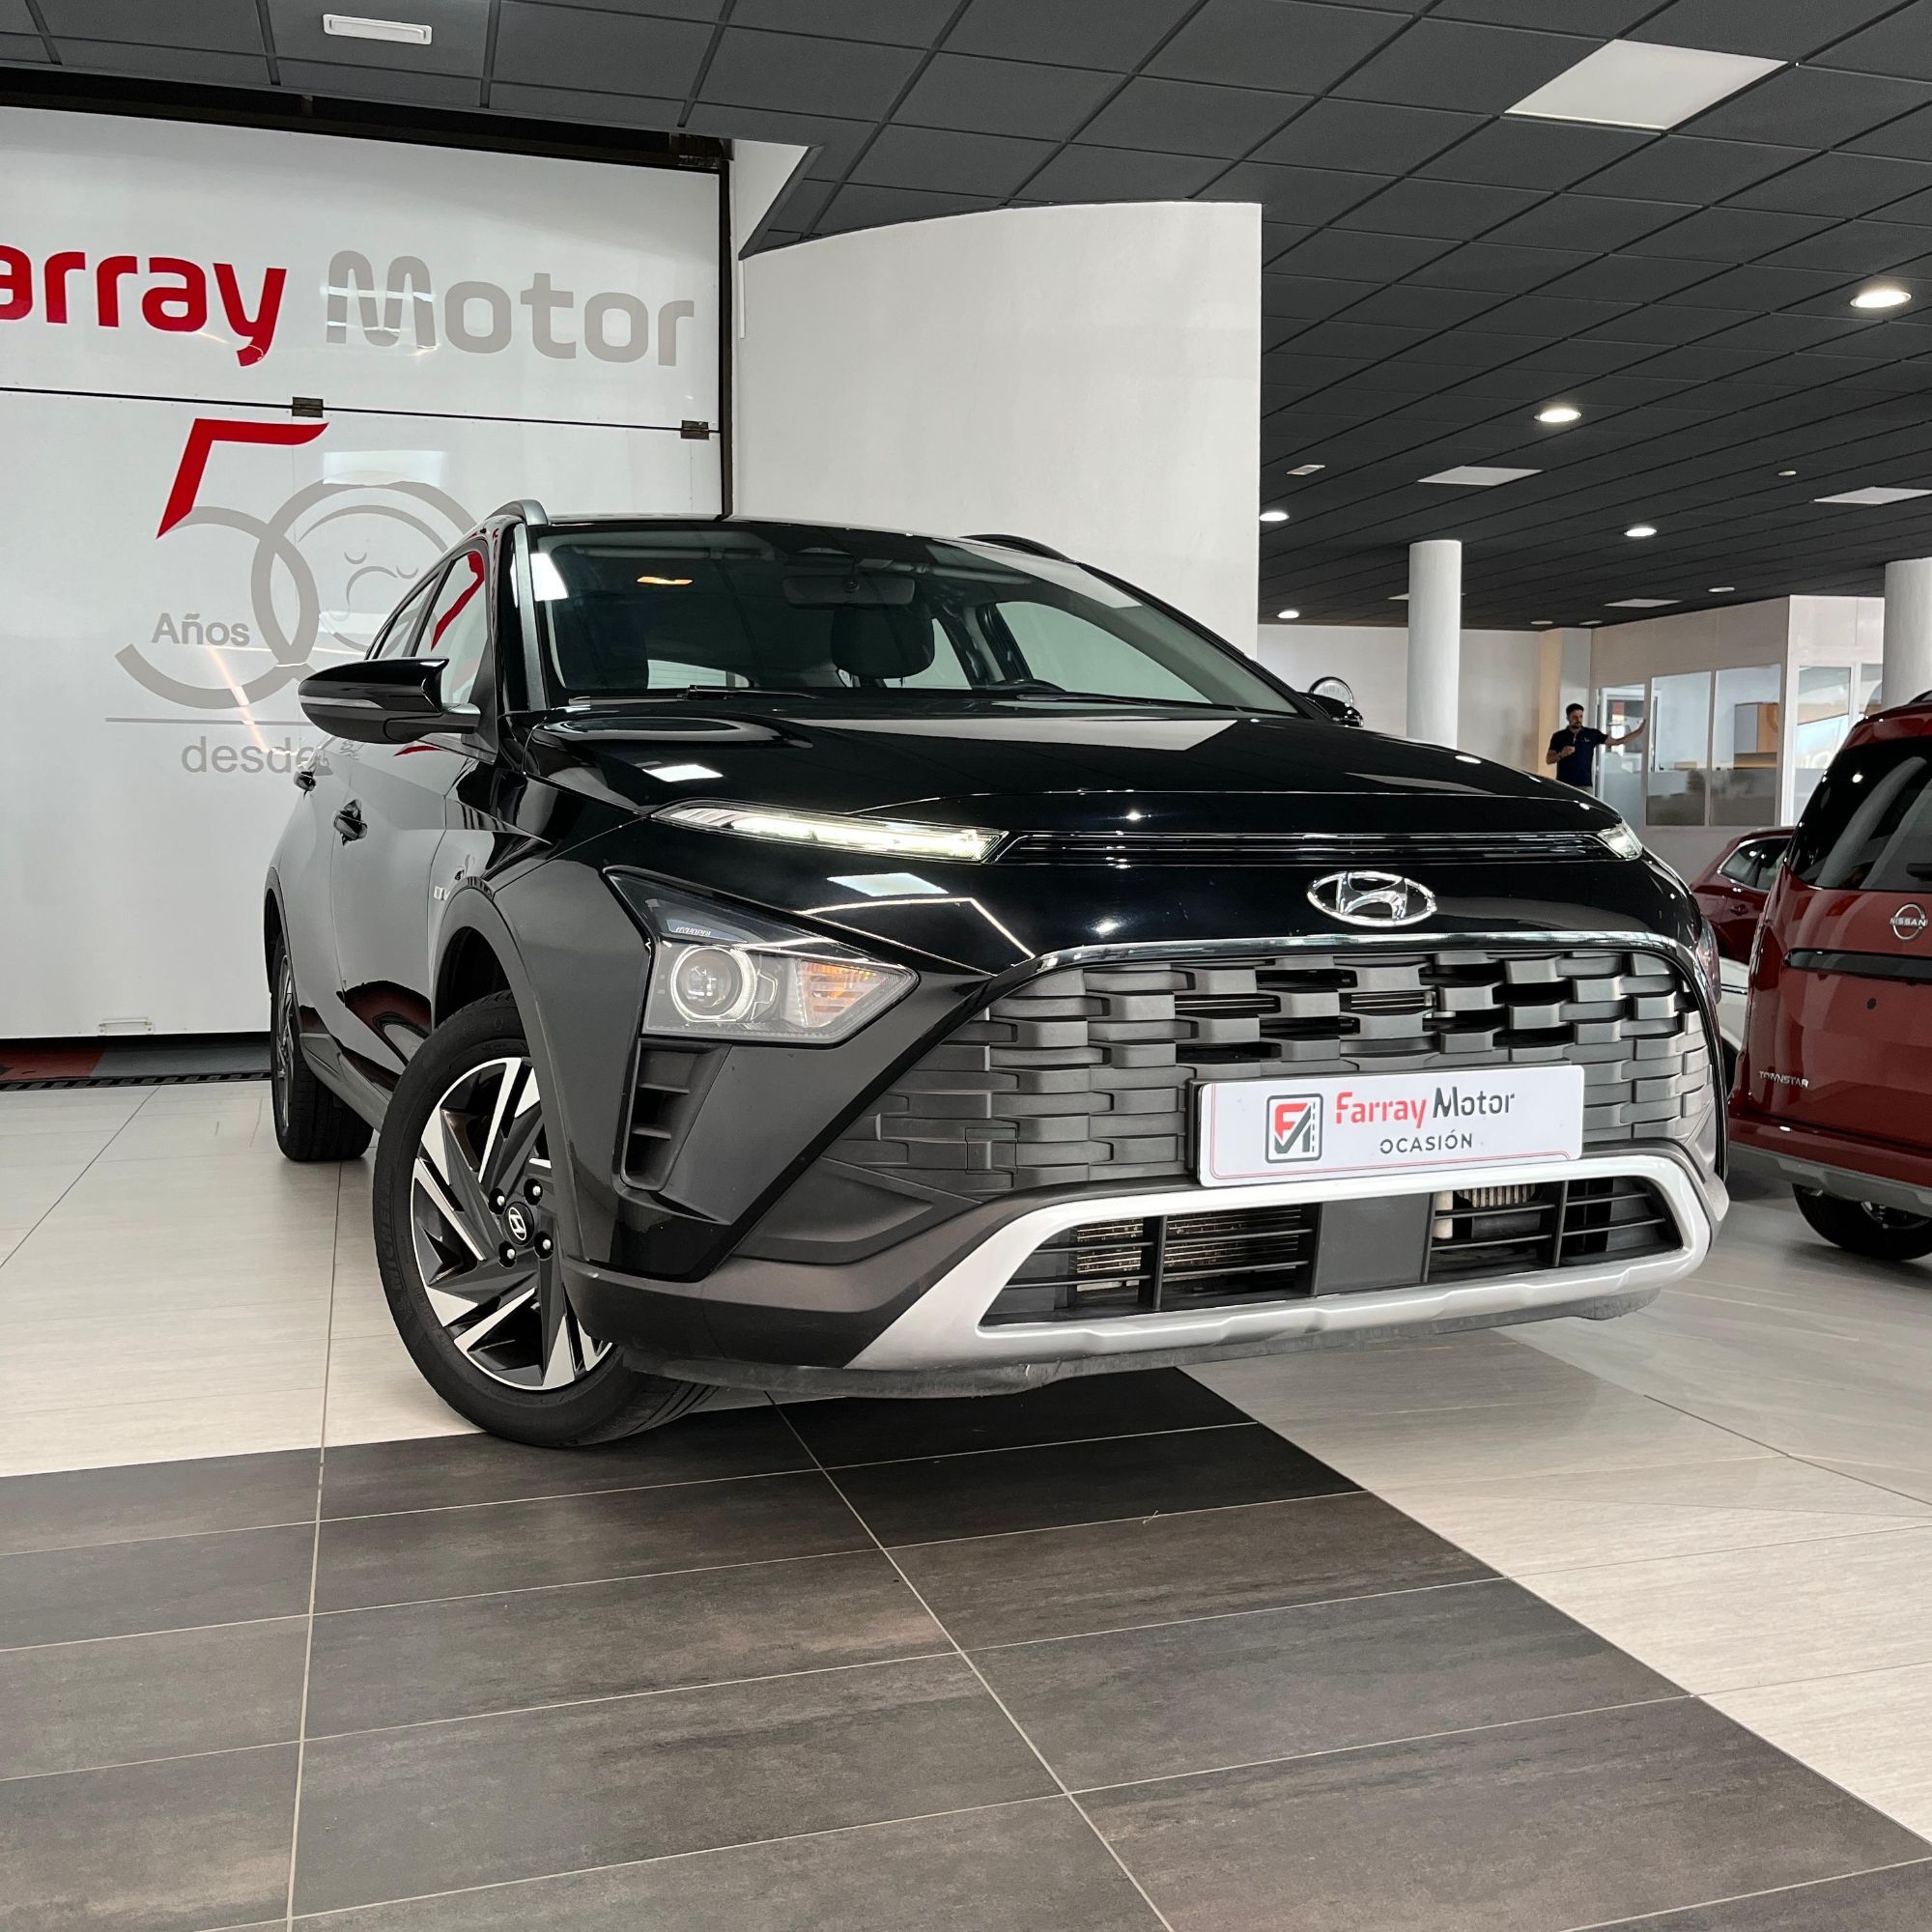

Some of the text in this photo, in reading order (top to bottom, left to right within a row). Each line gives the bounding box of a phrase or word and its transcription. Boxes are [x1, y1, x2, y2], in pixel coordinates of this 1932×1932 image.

[0, 244, 695, 367] array Motor
[151, 612, 250, 647] Años
[1889, 917, 1928, 927] NISSAN
[1335, 1087, 1516, 1129] Farray Motor
[1379, 1129, 1472, 1154] OCASIÓN
